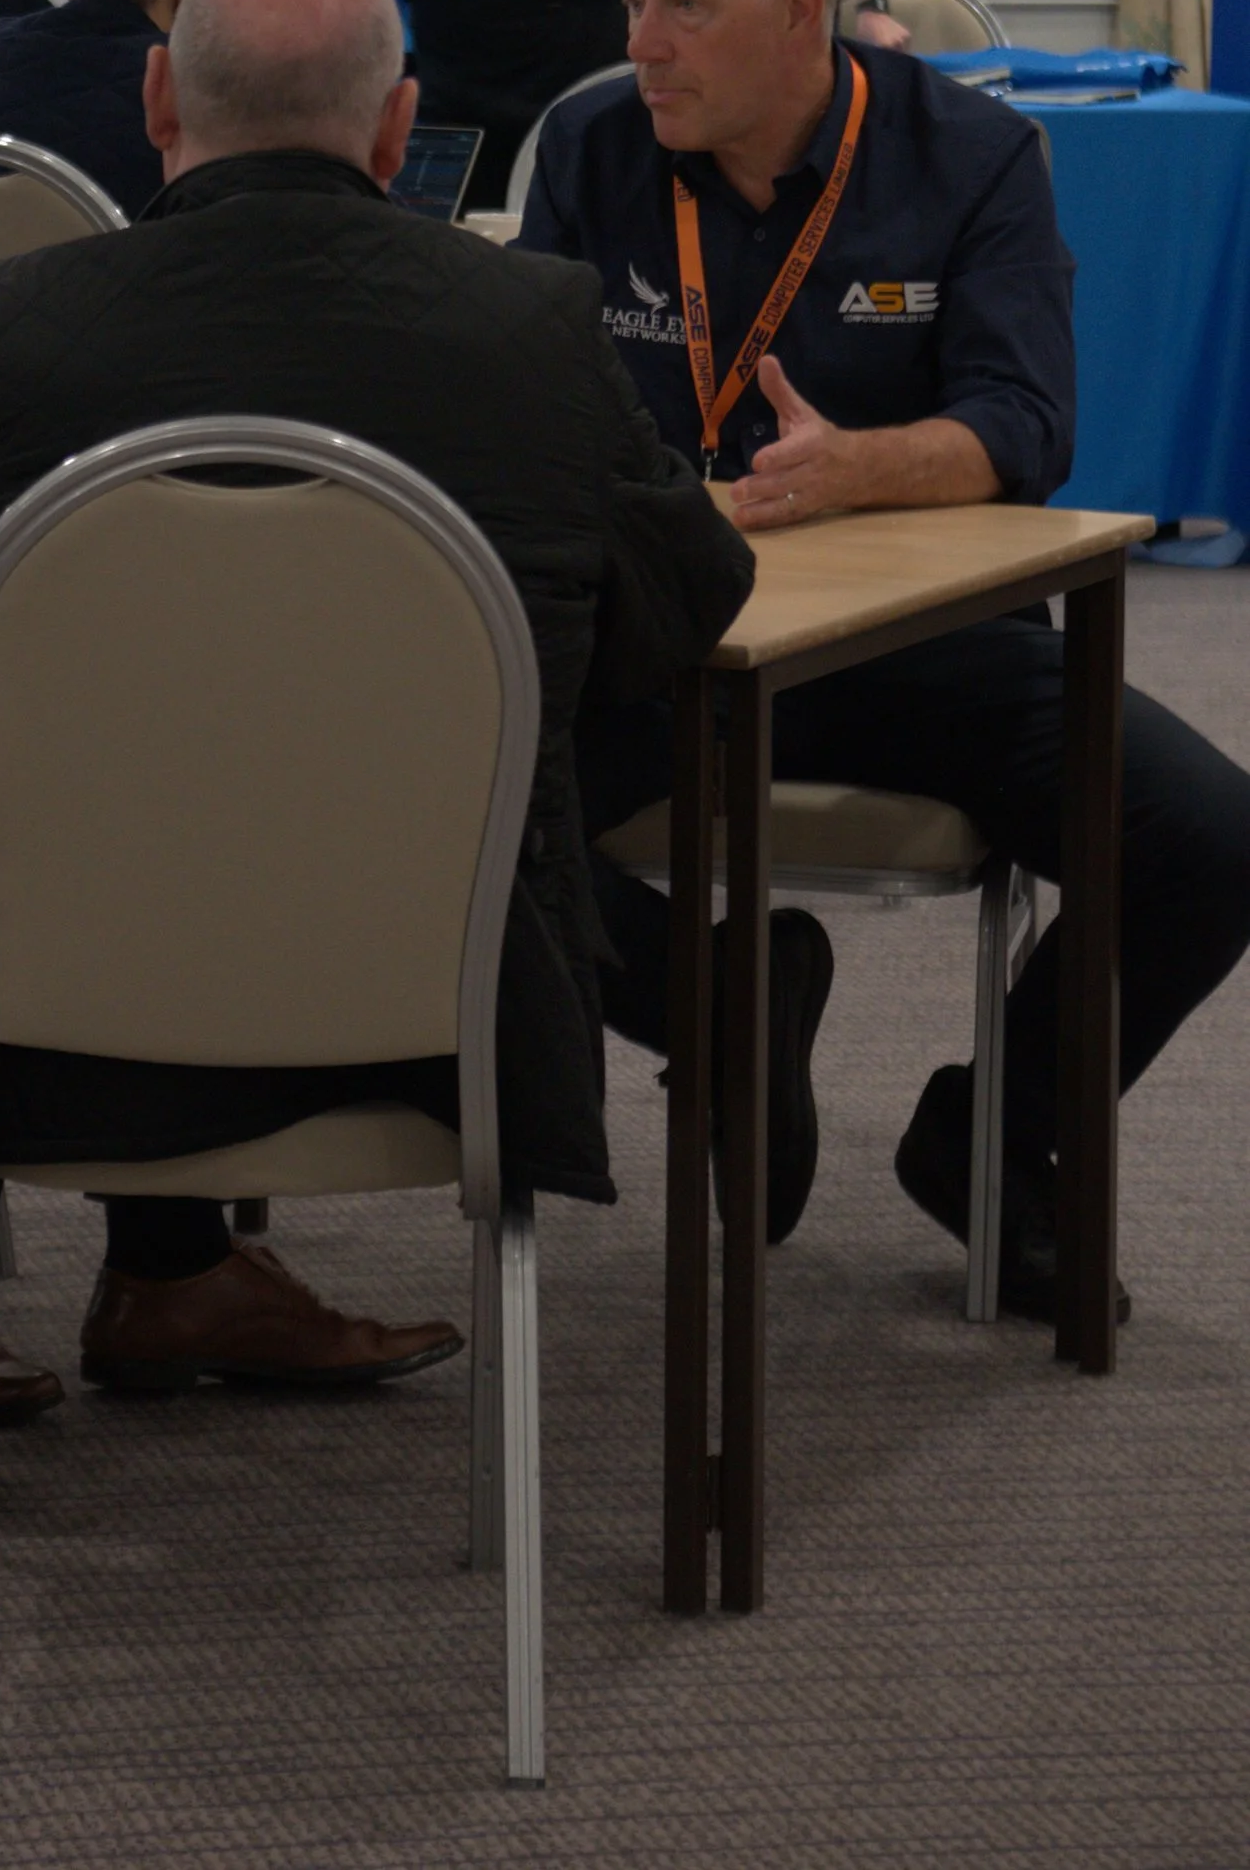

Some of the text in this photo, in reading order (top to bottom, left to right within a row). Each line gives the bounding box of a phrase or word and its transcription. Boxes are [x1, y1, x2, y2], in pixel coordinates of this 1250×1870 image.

[735, 142, 854, 384] ASE COMPUTER SERVICES LIMITED
[838, 281, 941, 314] ASE
[602, 306, 686, 333] EAGLE EY
[685, 285, 708, 342] ASE
[843, 313, 881, 325] COMPUTER
[612, 326, 686, 345] NETWORKS
